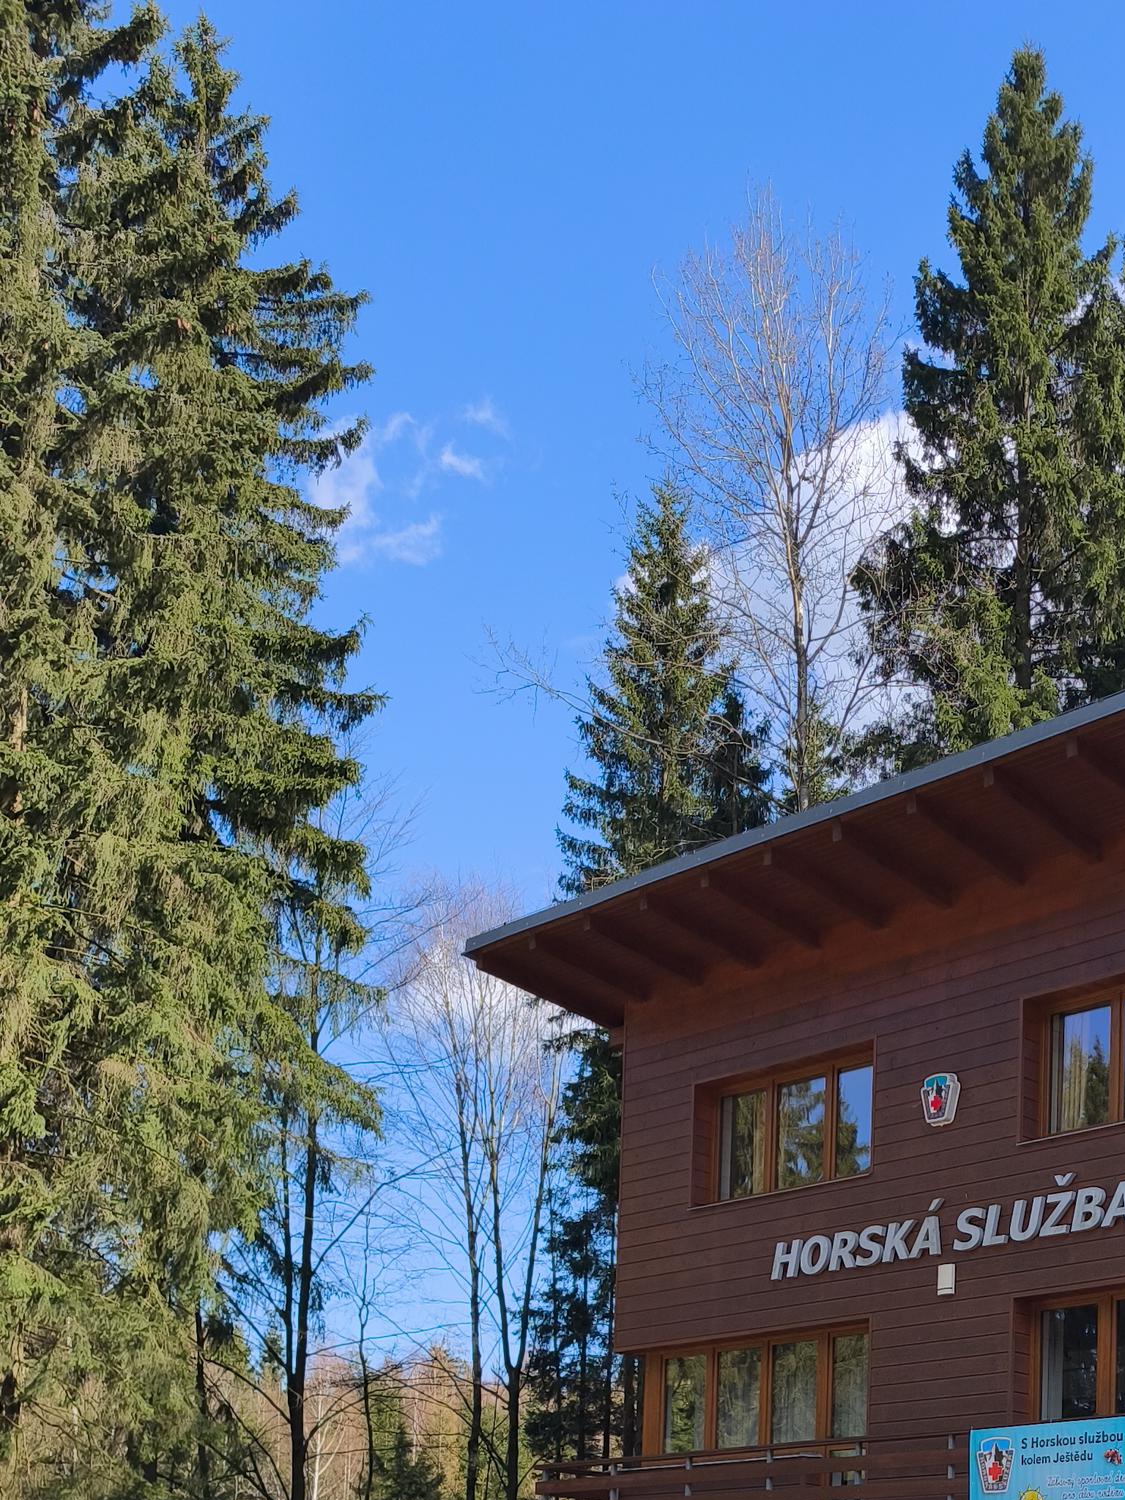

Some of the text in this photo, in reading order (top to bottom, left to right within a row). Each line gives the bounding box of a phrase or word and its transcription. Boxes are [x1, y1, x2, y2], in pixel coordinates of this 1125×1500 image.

[770, 1197, 945, 1280] HORSKÁ
[1021, 1431, 1124, 1449] S Horskou službou
[1021, 1449, 1093, 1466] kolem Ještědu
